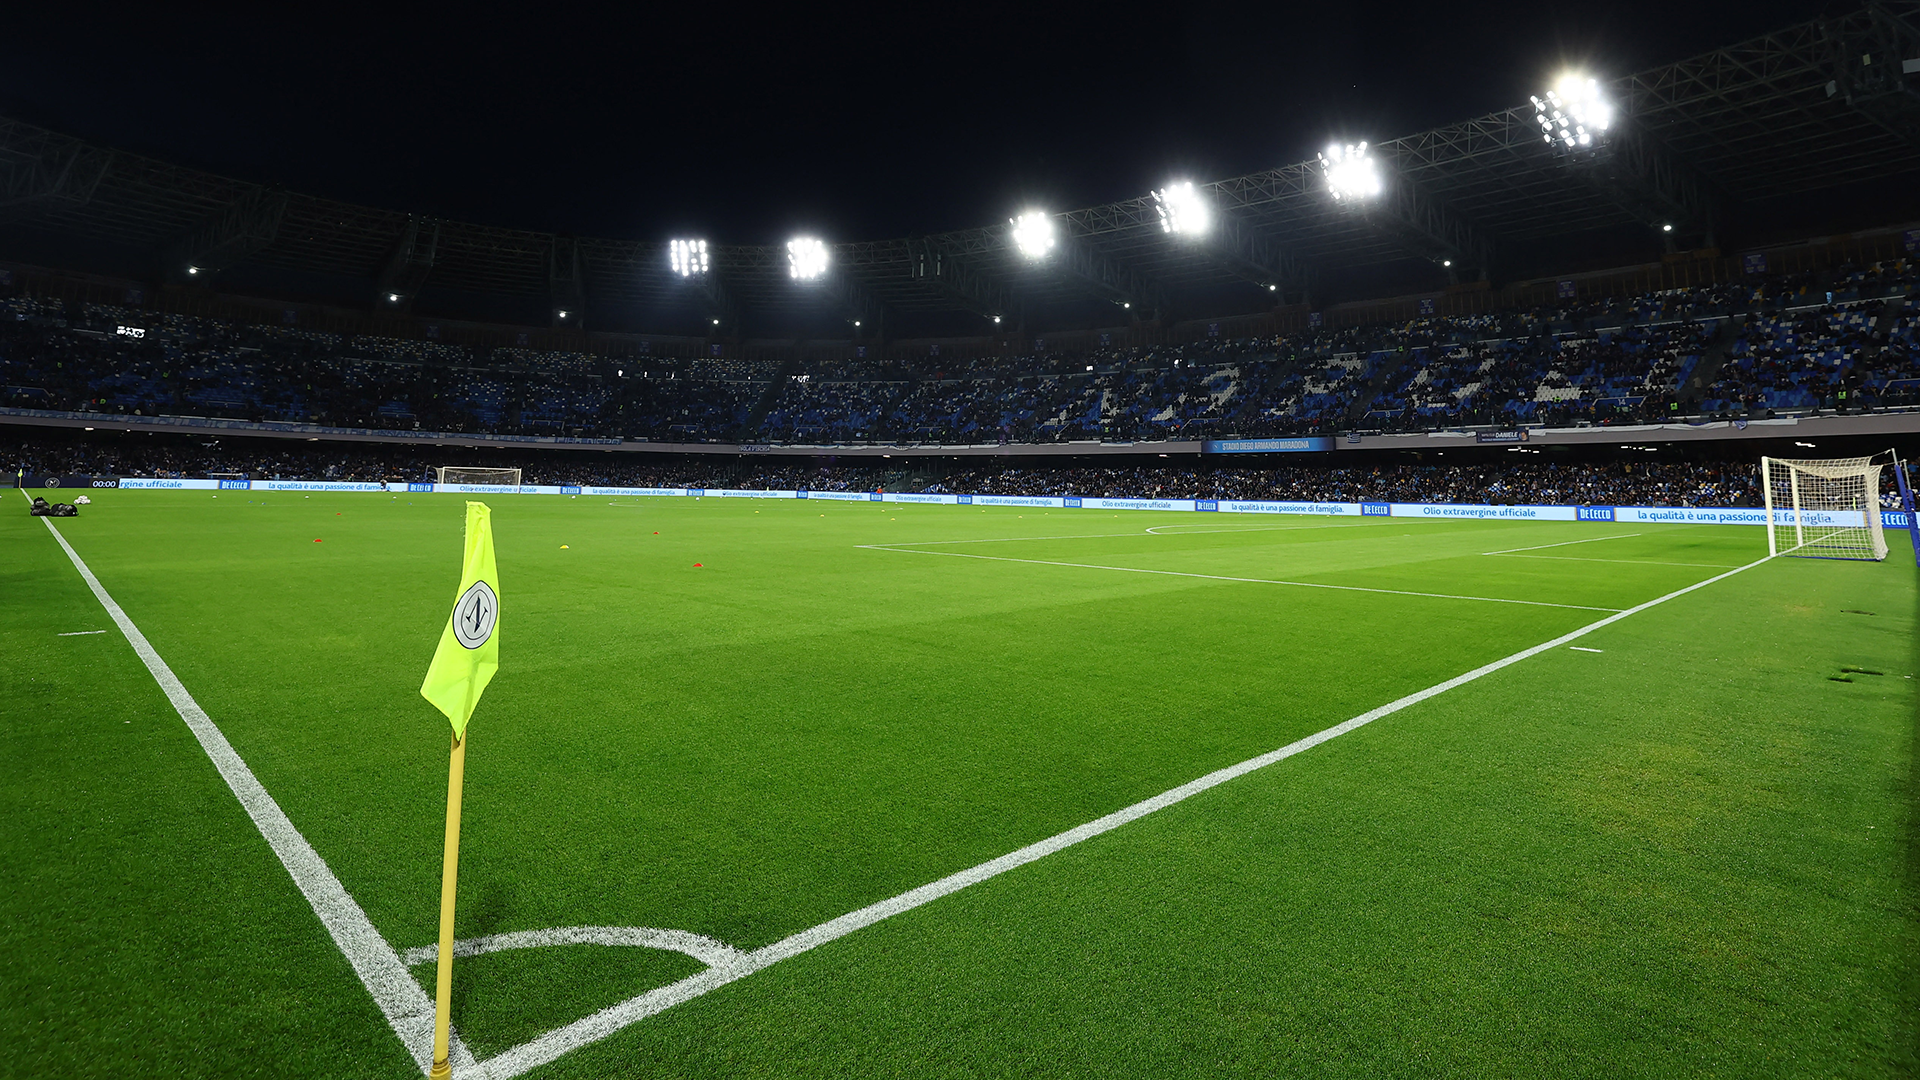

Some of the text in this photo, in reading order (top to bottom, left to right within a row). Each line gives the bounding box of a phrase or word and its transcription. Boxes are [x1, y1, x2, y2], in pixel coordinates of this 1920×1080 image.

[1222, 442, 1239, 451] STADIO
[1240, 442, 1254, 450] DIEGO
[1254, 441, 1279, 450] ARMANDO
[1280, 440, 1310, 450] MARADONA
[92, 480, 116, 488] 00:00
[146, 480, 182, 488] ufficiale
[277, 482, 302, 491] qualità
[325, 483, 354, 492] passione
[474, 486, 512, 494] extravergine
[631, 489, 650, 497] passione
[1114, 501, 1148, 510] extravergine
[1149, 501, 1172, 509] ufficiale
[1238, 503, 1259, 512] qualità
[1260, 503, 1265, 511] è
[1278, 504, 1306, 514] passione
[1308, 504, 1314, 512] di
[1315, 504, 1344, 515] famiglia.
[1364, 504, 1388, 515] DE CECCO
[1423, 507, 1536, 519] Olio extravergine ufficiale
[1580, 508, 1611, 520] DE CECCO
[1638, 510, 1648, 520] la
[1649, 510, 1685, 522] qualità
[1687, 511, 1694, 521] è
[1696, 513, 1717, 521] una
[1719, 512, 1767, 524] passione
